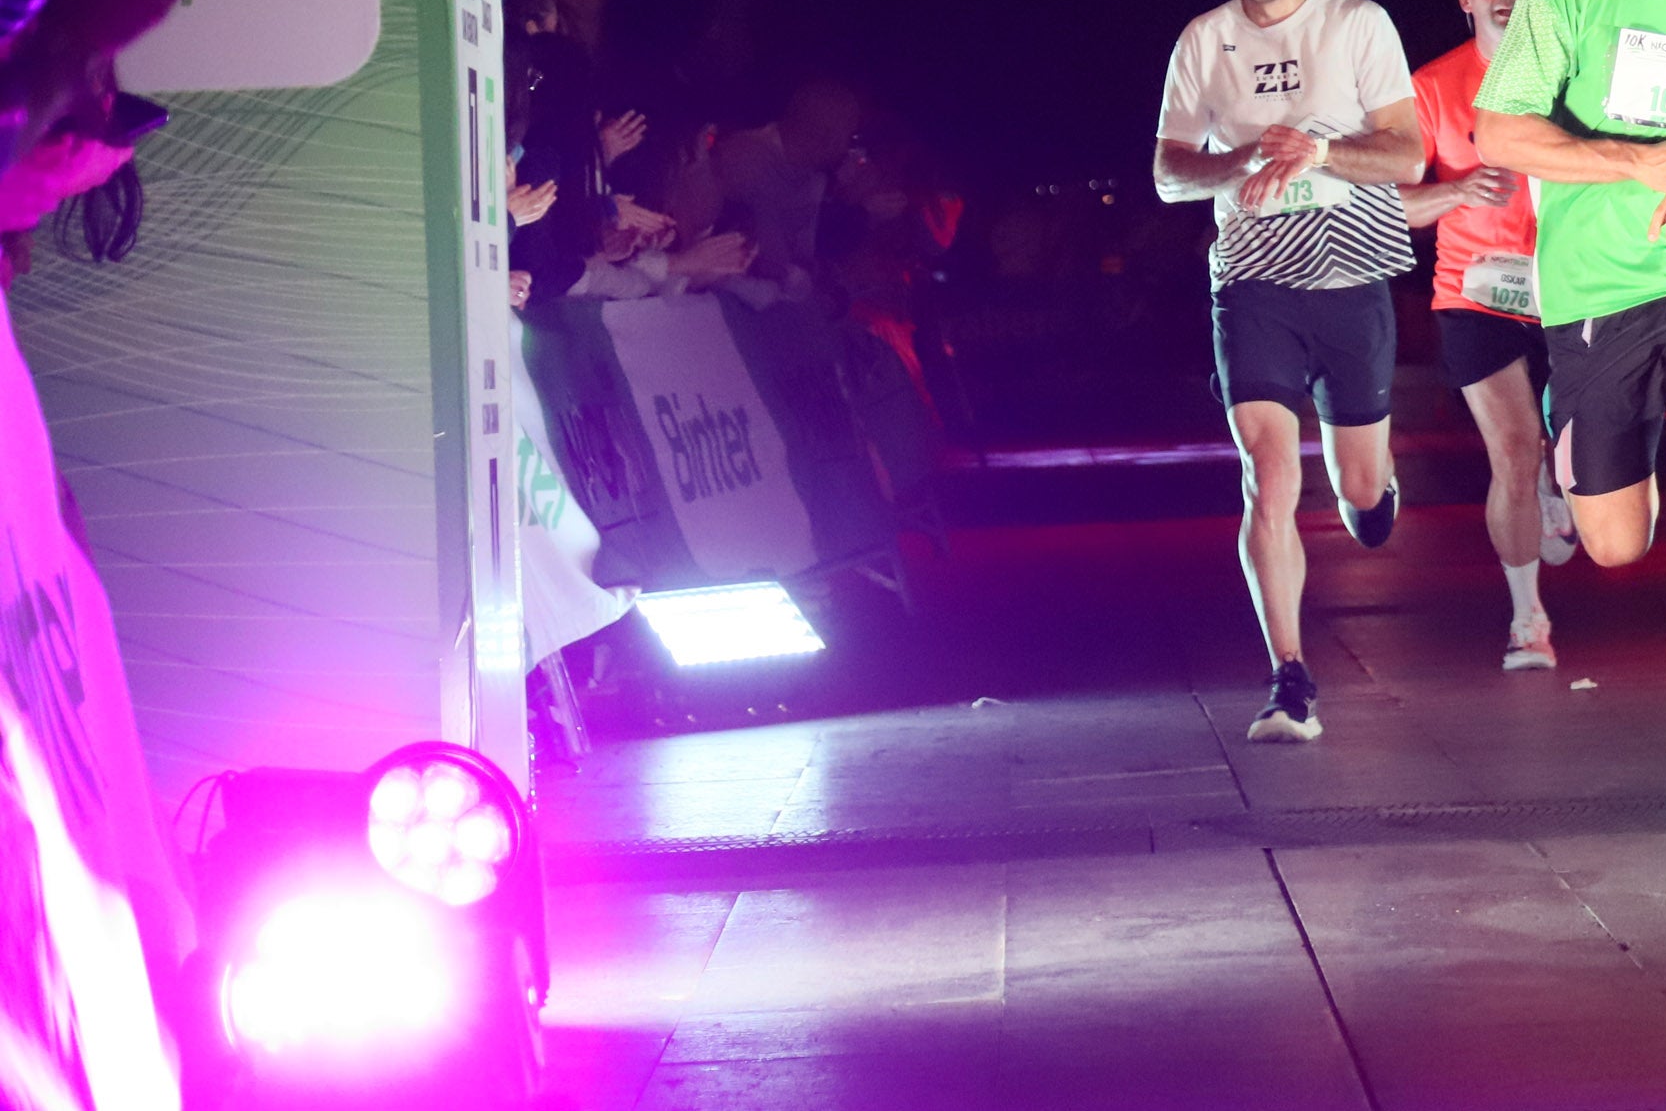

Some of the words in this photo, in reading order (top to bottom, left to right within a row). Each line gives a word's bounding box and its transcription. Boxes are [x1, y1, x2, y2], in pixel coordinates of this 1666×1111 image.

[1501, 273, 1526, 286] OSKAR
[1491, 286, 1530, 308] 1076
[653, 392, 763, 504] Binter
